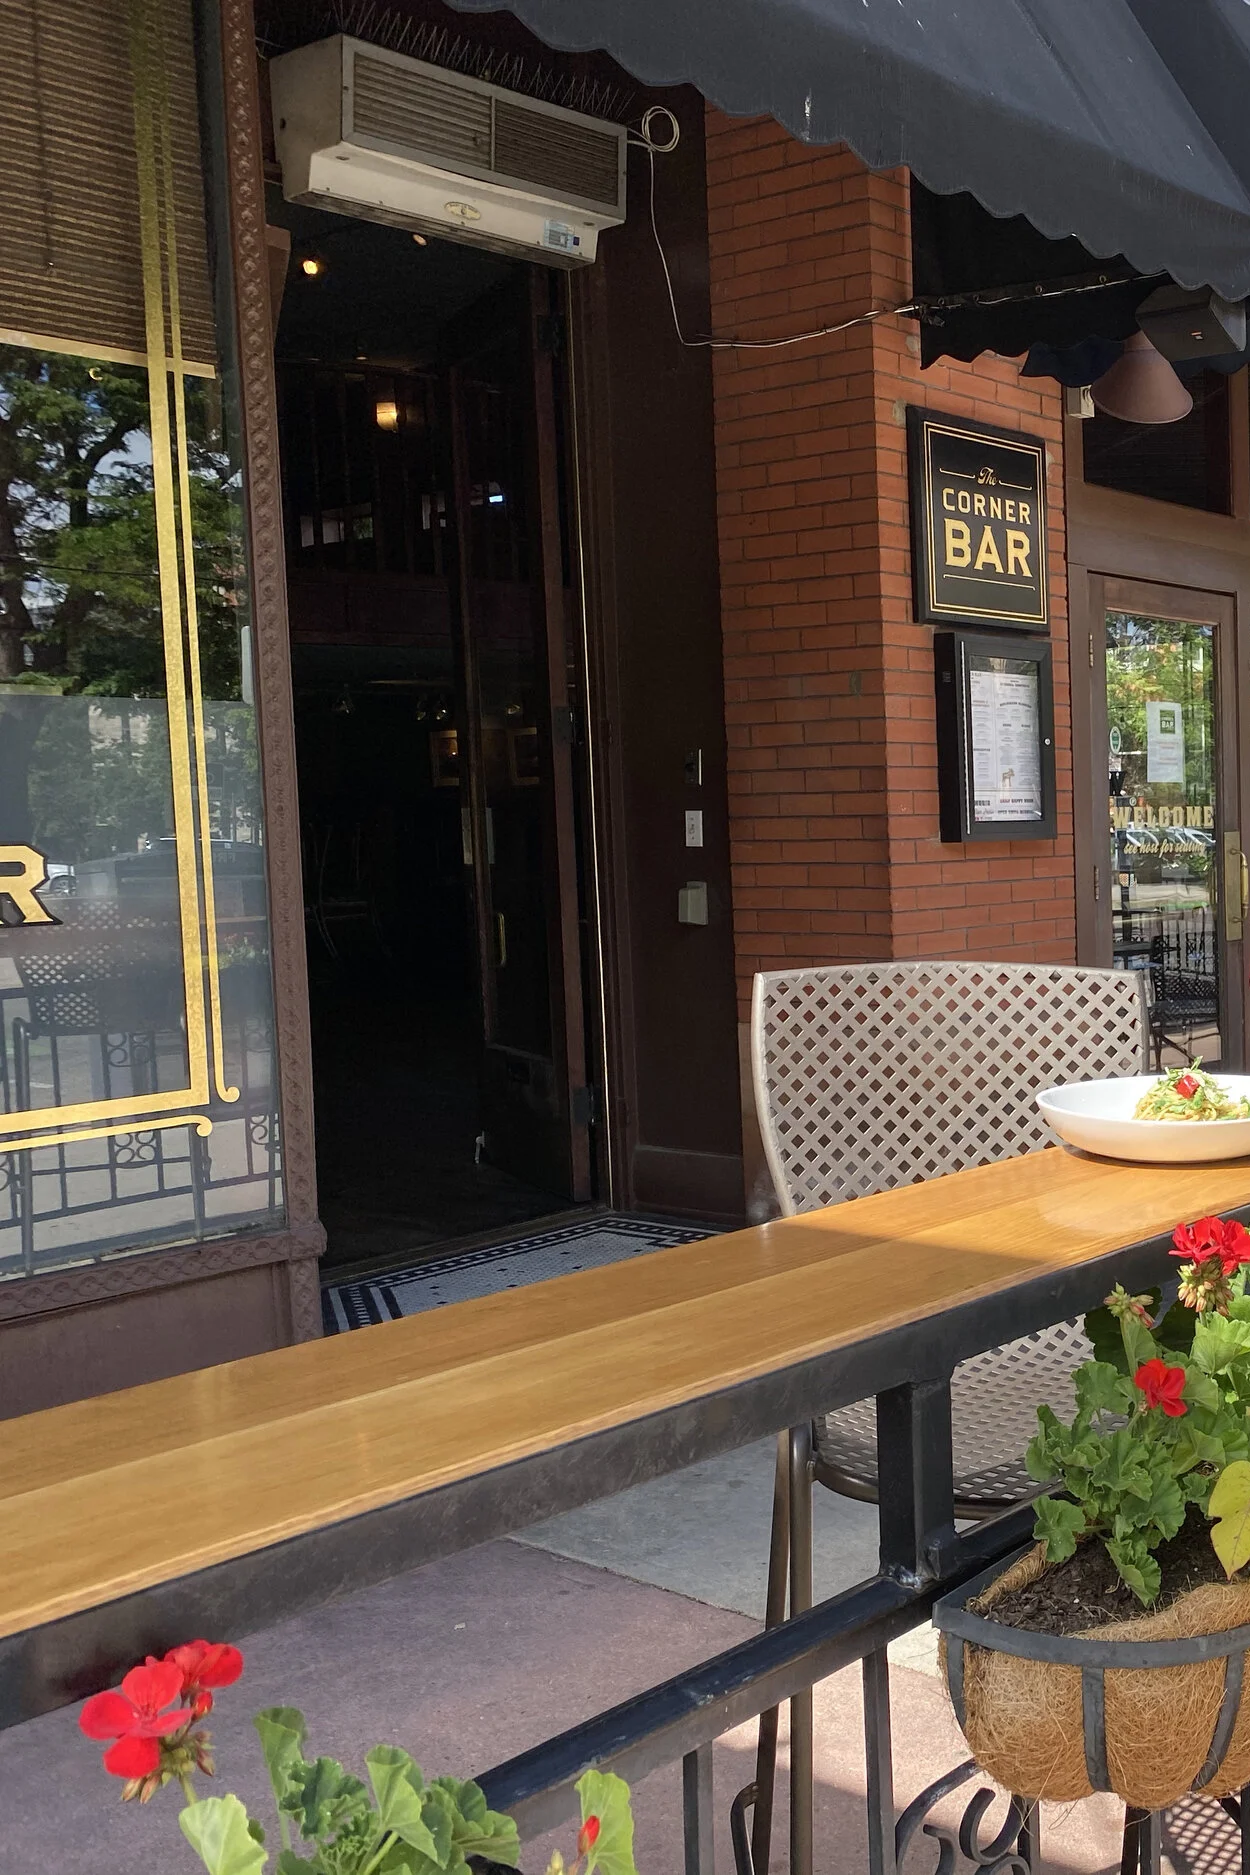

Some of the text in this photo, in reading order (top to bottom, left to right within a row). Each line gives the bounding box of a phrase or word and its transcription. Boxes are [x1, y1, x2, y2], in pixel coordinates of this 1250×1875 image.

[977, 466, 998, 486] The
[942, 487, 1031, 525] CORNER
[943, 517, 1033, 578] BAR
[1113, 806, 1215, 829] WELCOME
[1123, 843, 1138, 855] see
[1158, 838, 1173, 858] for
